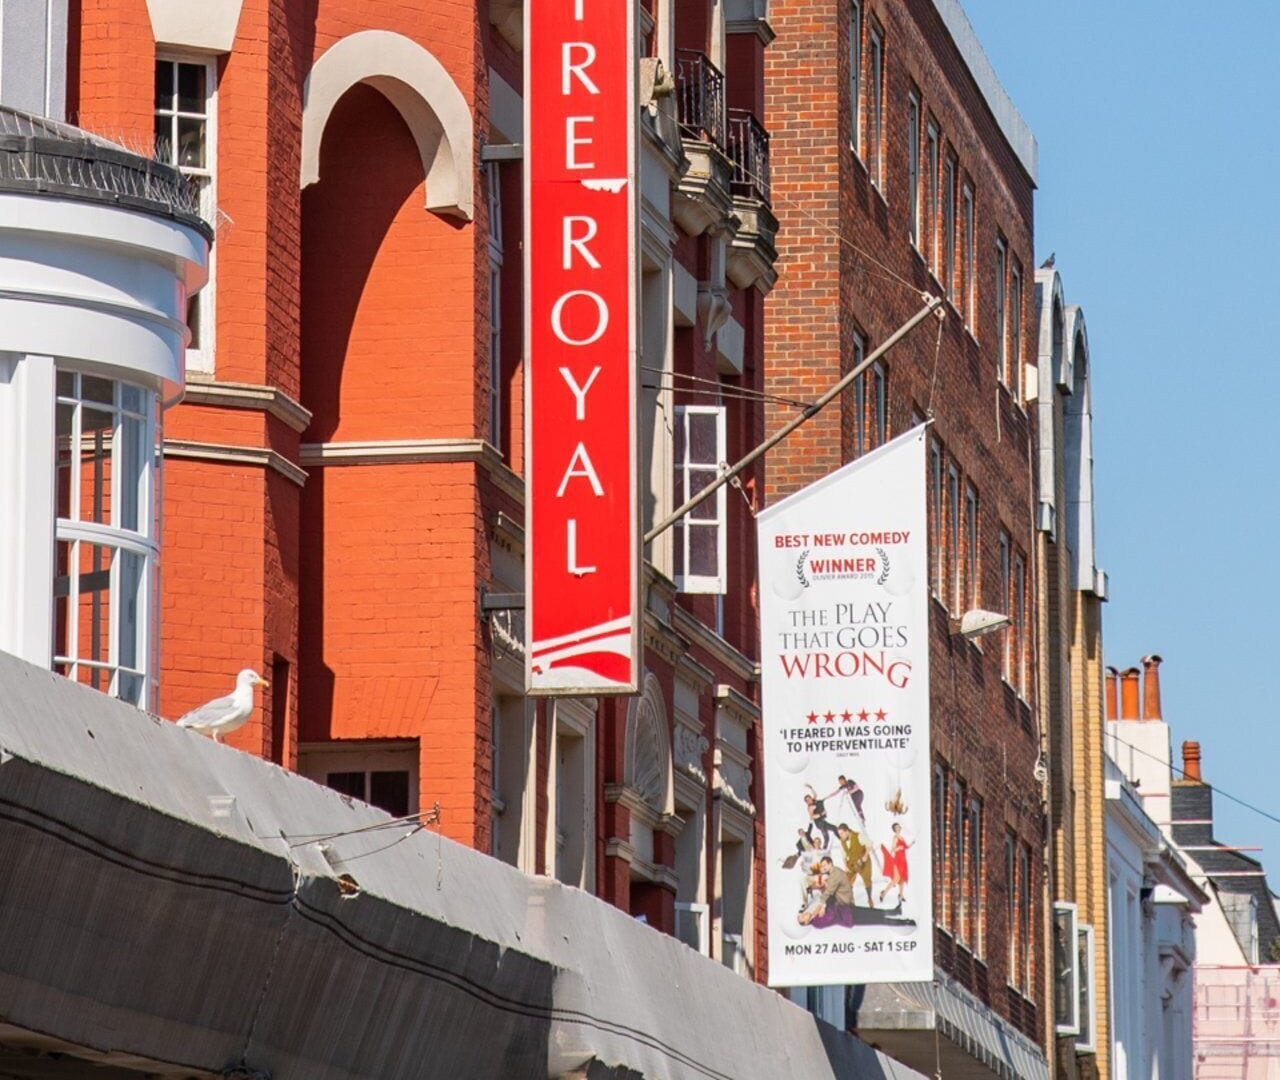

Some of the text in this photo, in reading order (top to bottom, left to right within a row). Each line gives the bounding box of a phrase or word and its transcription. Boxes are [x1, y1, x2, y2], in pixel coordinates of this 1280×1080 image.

[550, 214, 610, 575] ROYAL
[775, 531, 911, 548] BEST NEW COMEDY
[810, 558, 876, 574] WINNER
[788, 602, 893, 627] THE PLAY
[779, 626, 908, 650] THAT GOES
[779, 651, 912, 689] WRONG
[790, 727, 835, 739] FEARED
[838, 727, 842, 737] I
[844, 725, 870, 737] WAS
[873, 724, 912, 736] GOING
[787, 741, 802, 753] TO
[785, 944, 812, 955] MON
[815, 943, 829, 954] 27
[831, 942, 855, 954] AUG
[864, 941, 885, 953] SAT
[888, 942, 893, 952] 1
[895, 940, 917, 952] SEP
